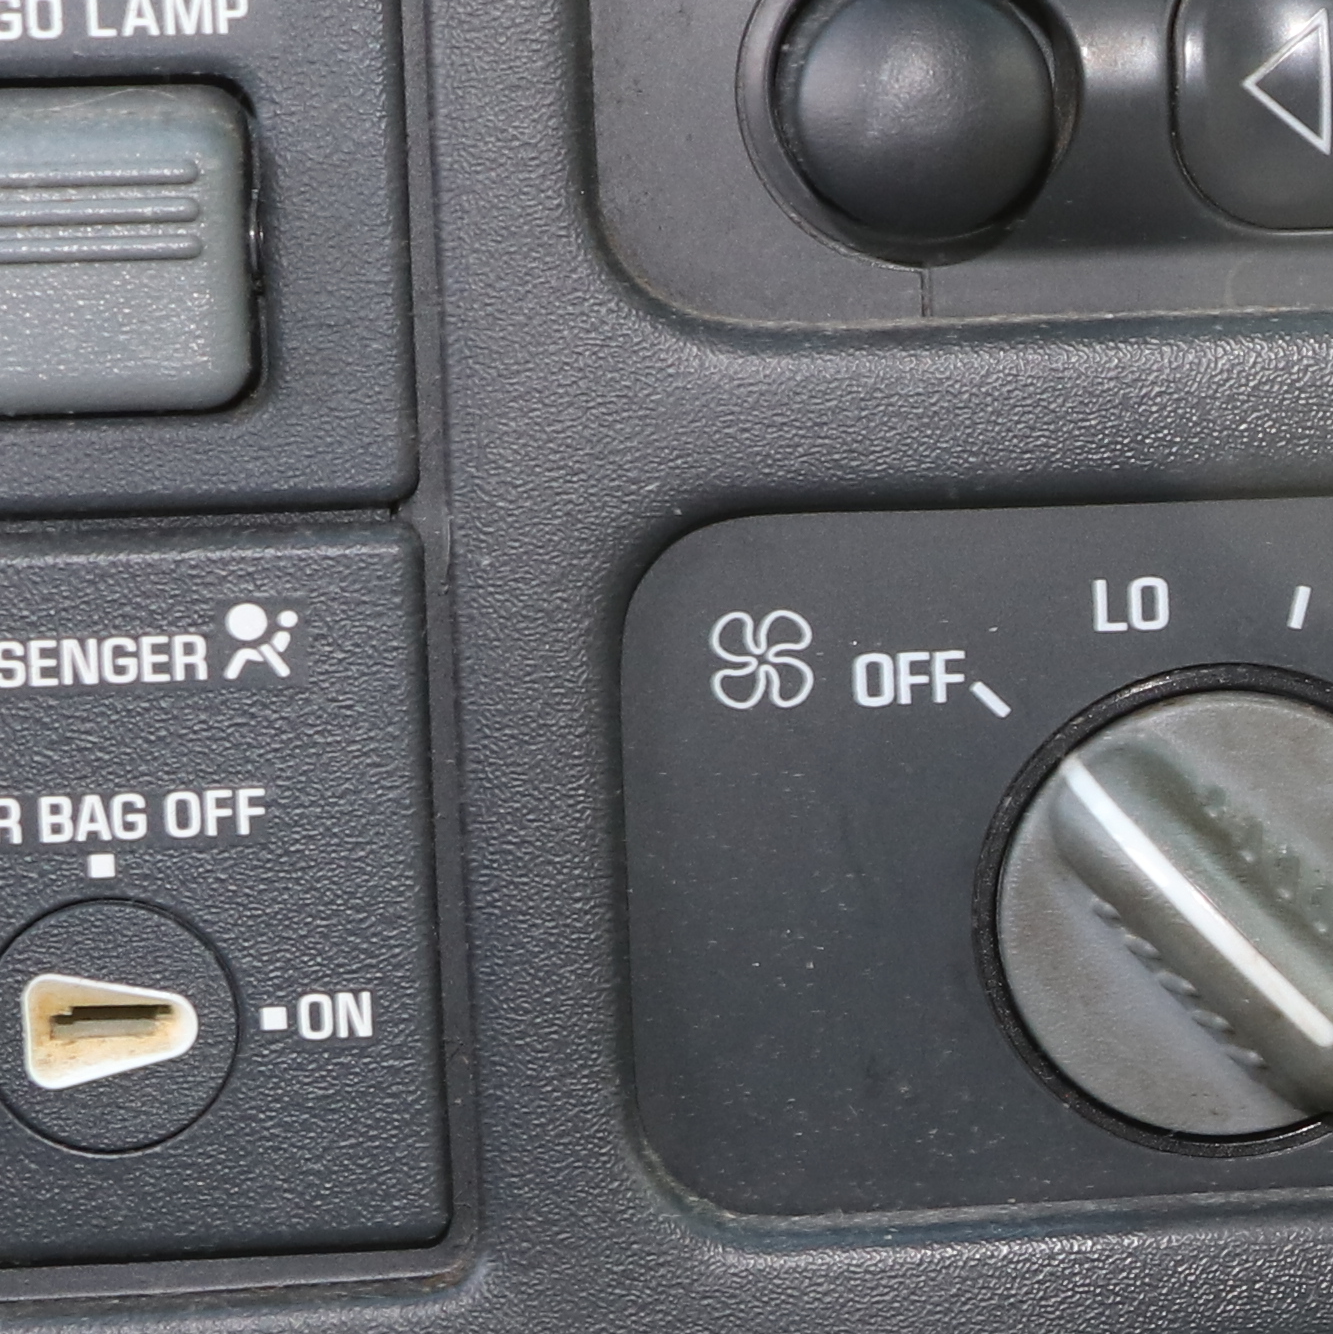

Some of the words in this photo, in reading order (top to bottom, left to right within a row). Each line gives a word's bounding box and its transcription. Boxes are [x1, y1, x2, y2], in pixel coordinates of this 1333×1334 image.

[1091, 576, 1170, 631] LO
[851, 650, 966, 708] OFF
[38, 792, 148, 844] BAG
[164, 788, 266, 838] OFF
[299, 991, 373, 1040] ON
